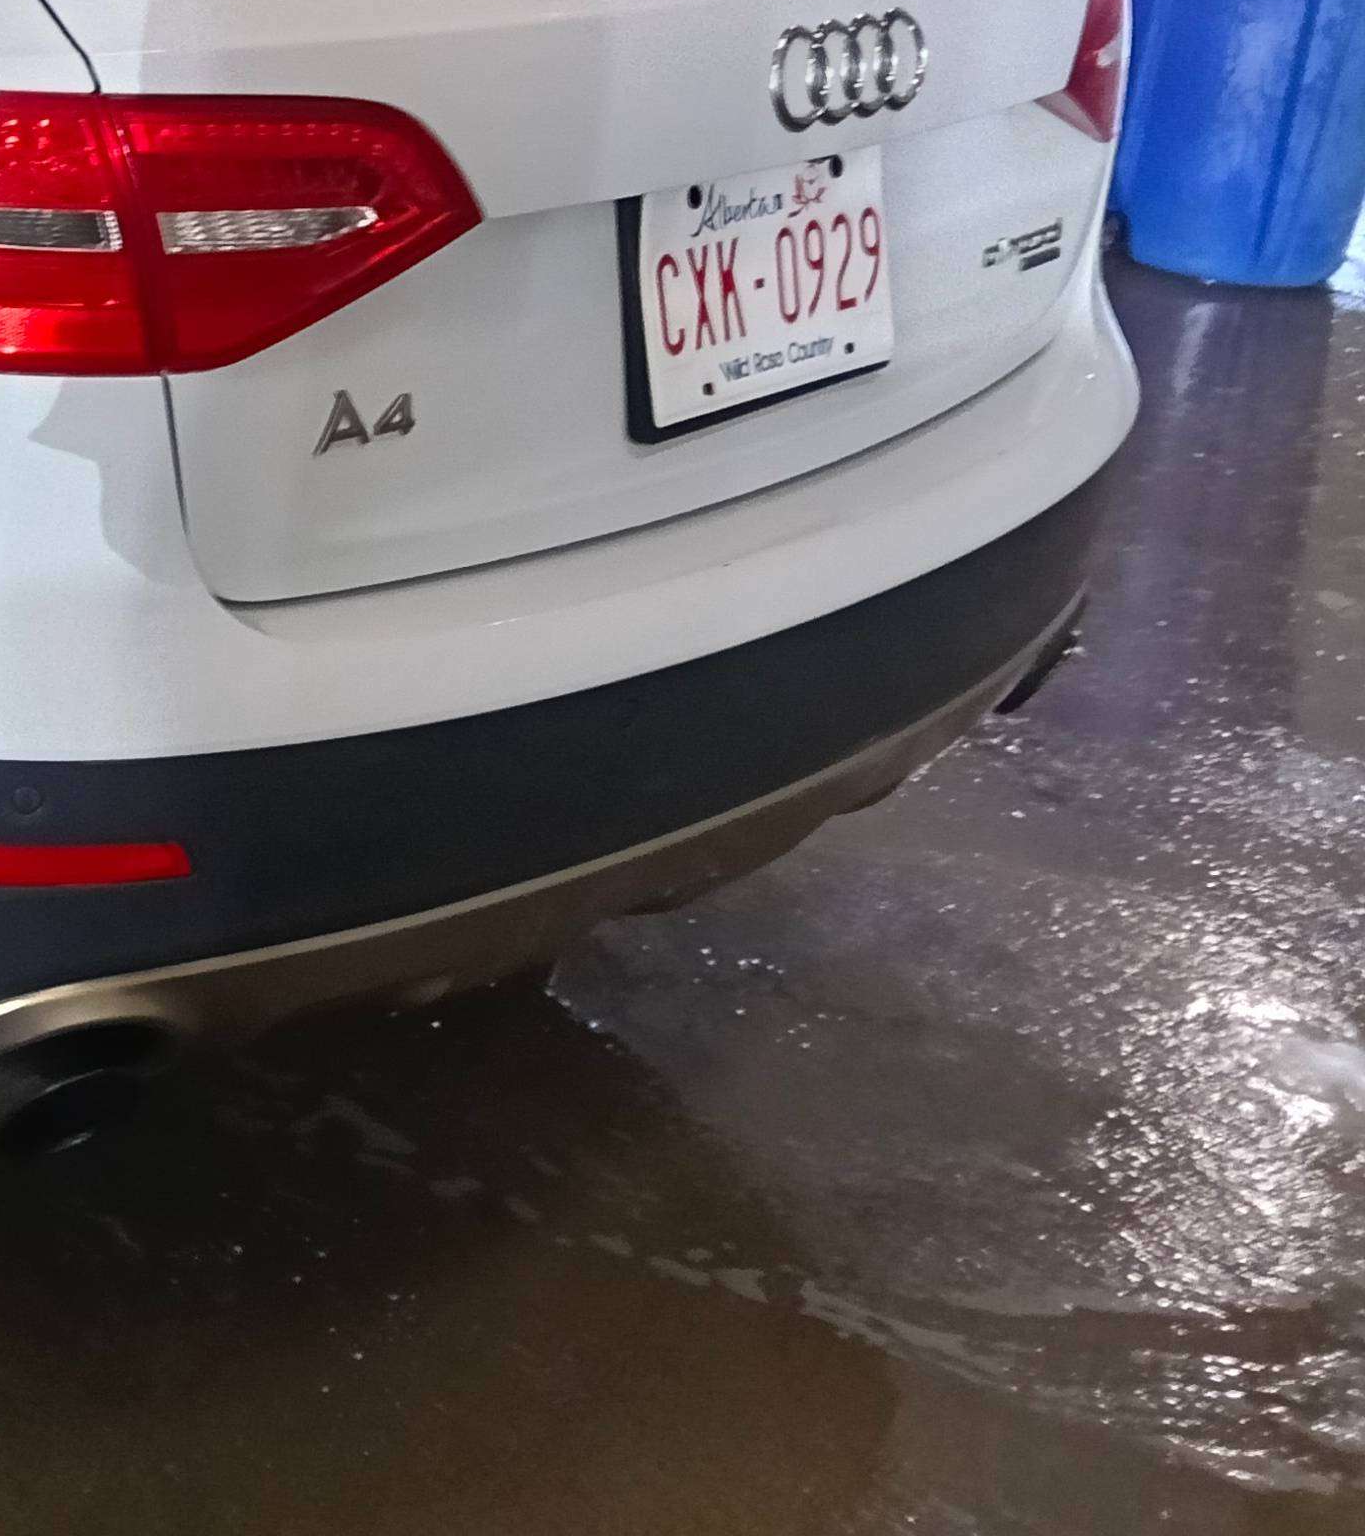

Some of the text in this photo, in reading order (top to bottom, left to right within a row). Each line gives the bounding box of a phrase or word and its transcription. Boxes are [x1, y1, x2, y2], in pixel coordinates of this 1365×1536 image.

[691, 182, 783, 237] Alberta
[656, 207, 880, 356] CXK-0929
[720, 357, 750, 381] Wild
[753, 341, 784, 371] Rose
[312, 390, 416, 456] A4
